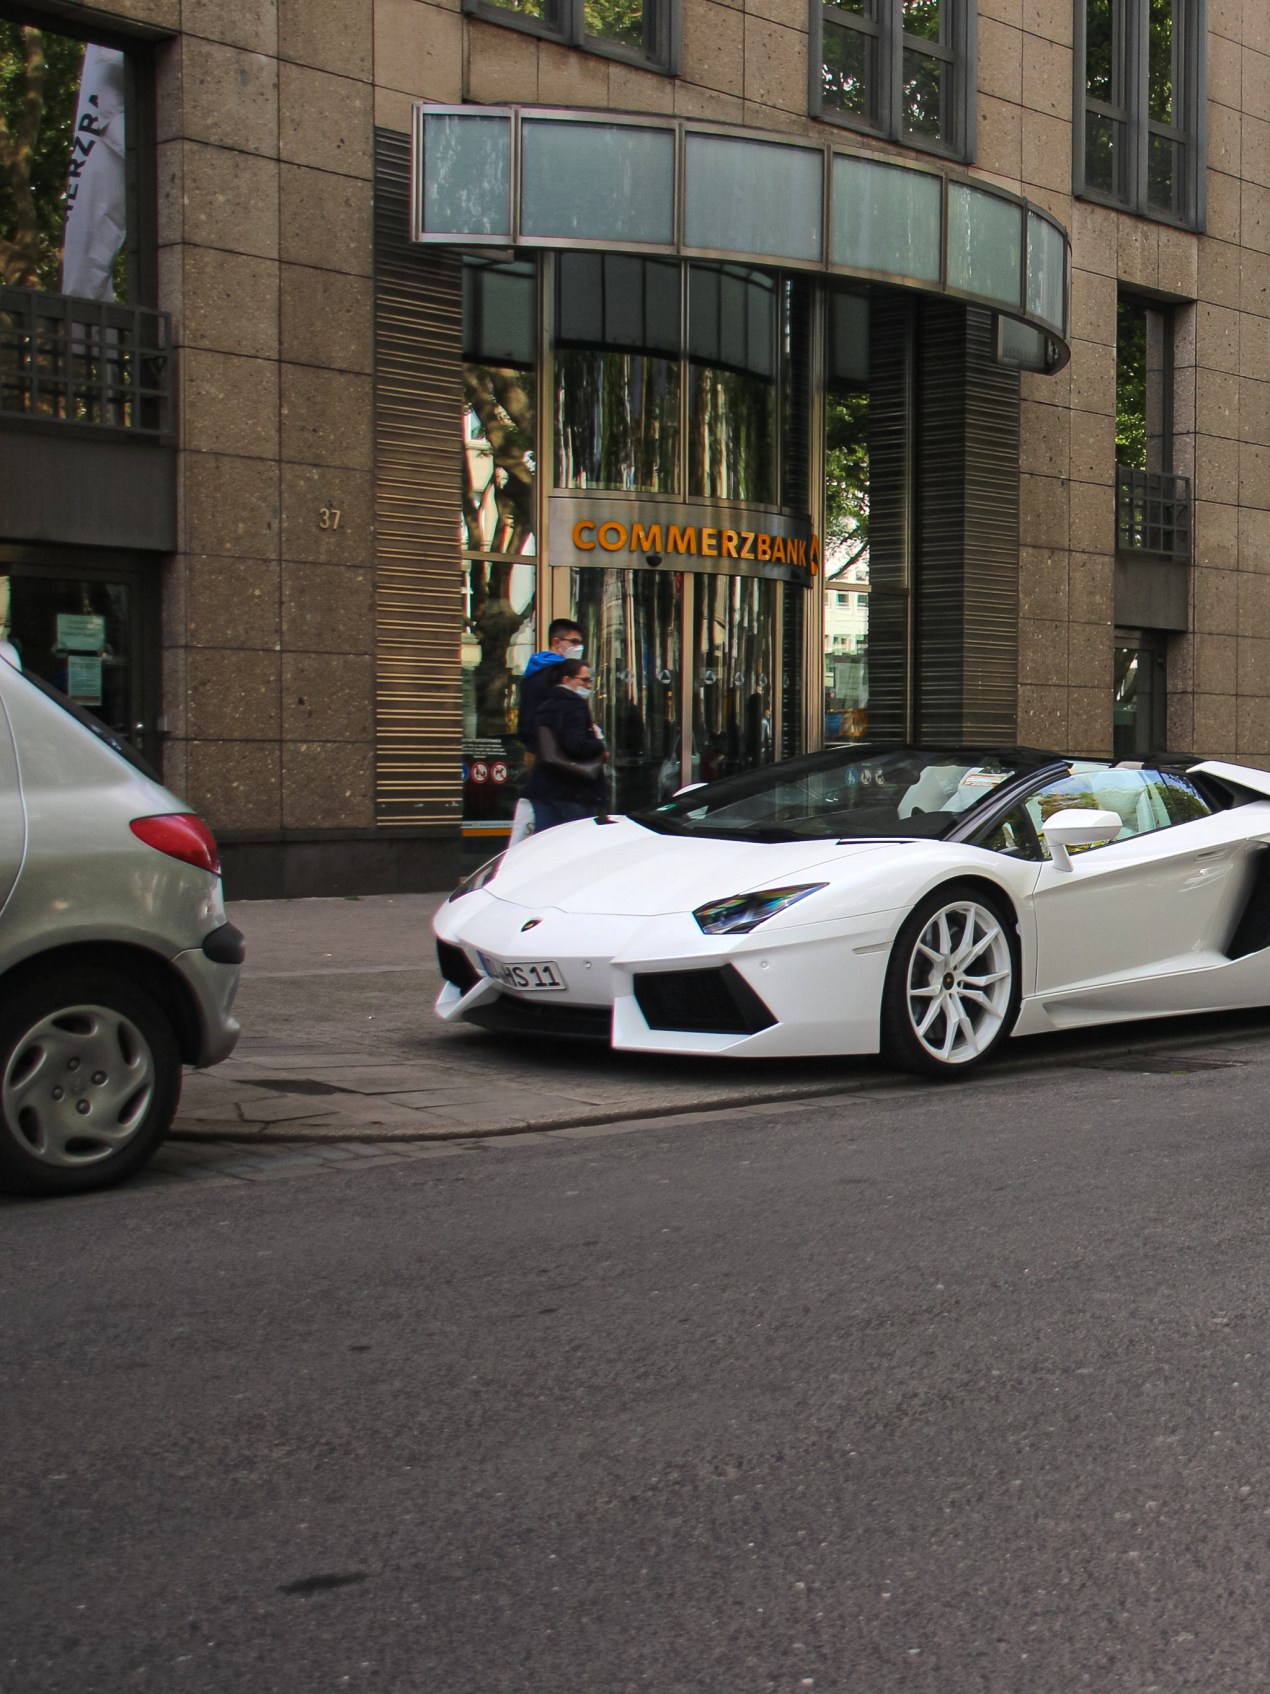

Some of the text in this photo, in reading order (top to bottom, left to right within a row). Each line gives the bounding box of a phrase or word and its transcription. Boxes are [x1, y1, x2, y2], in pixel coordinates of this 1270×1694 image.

[319, 508, 340, 529] 37
[572, 520, 807, 567] COMMERZBANK
[502, 963, 530, 987] HS
[530, 965, 560, 987] 11
